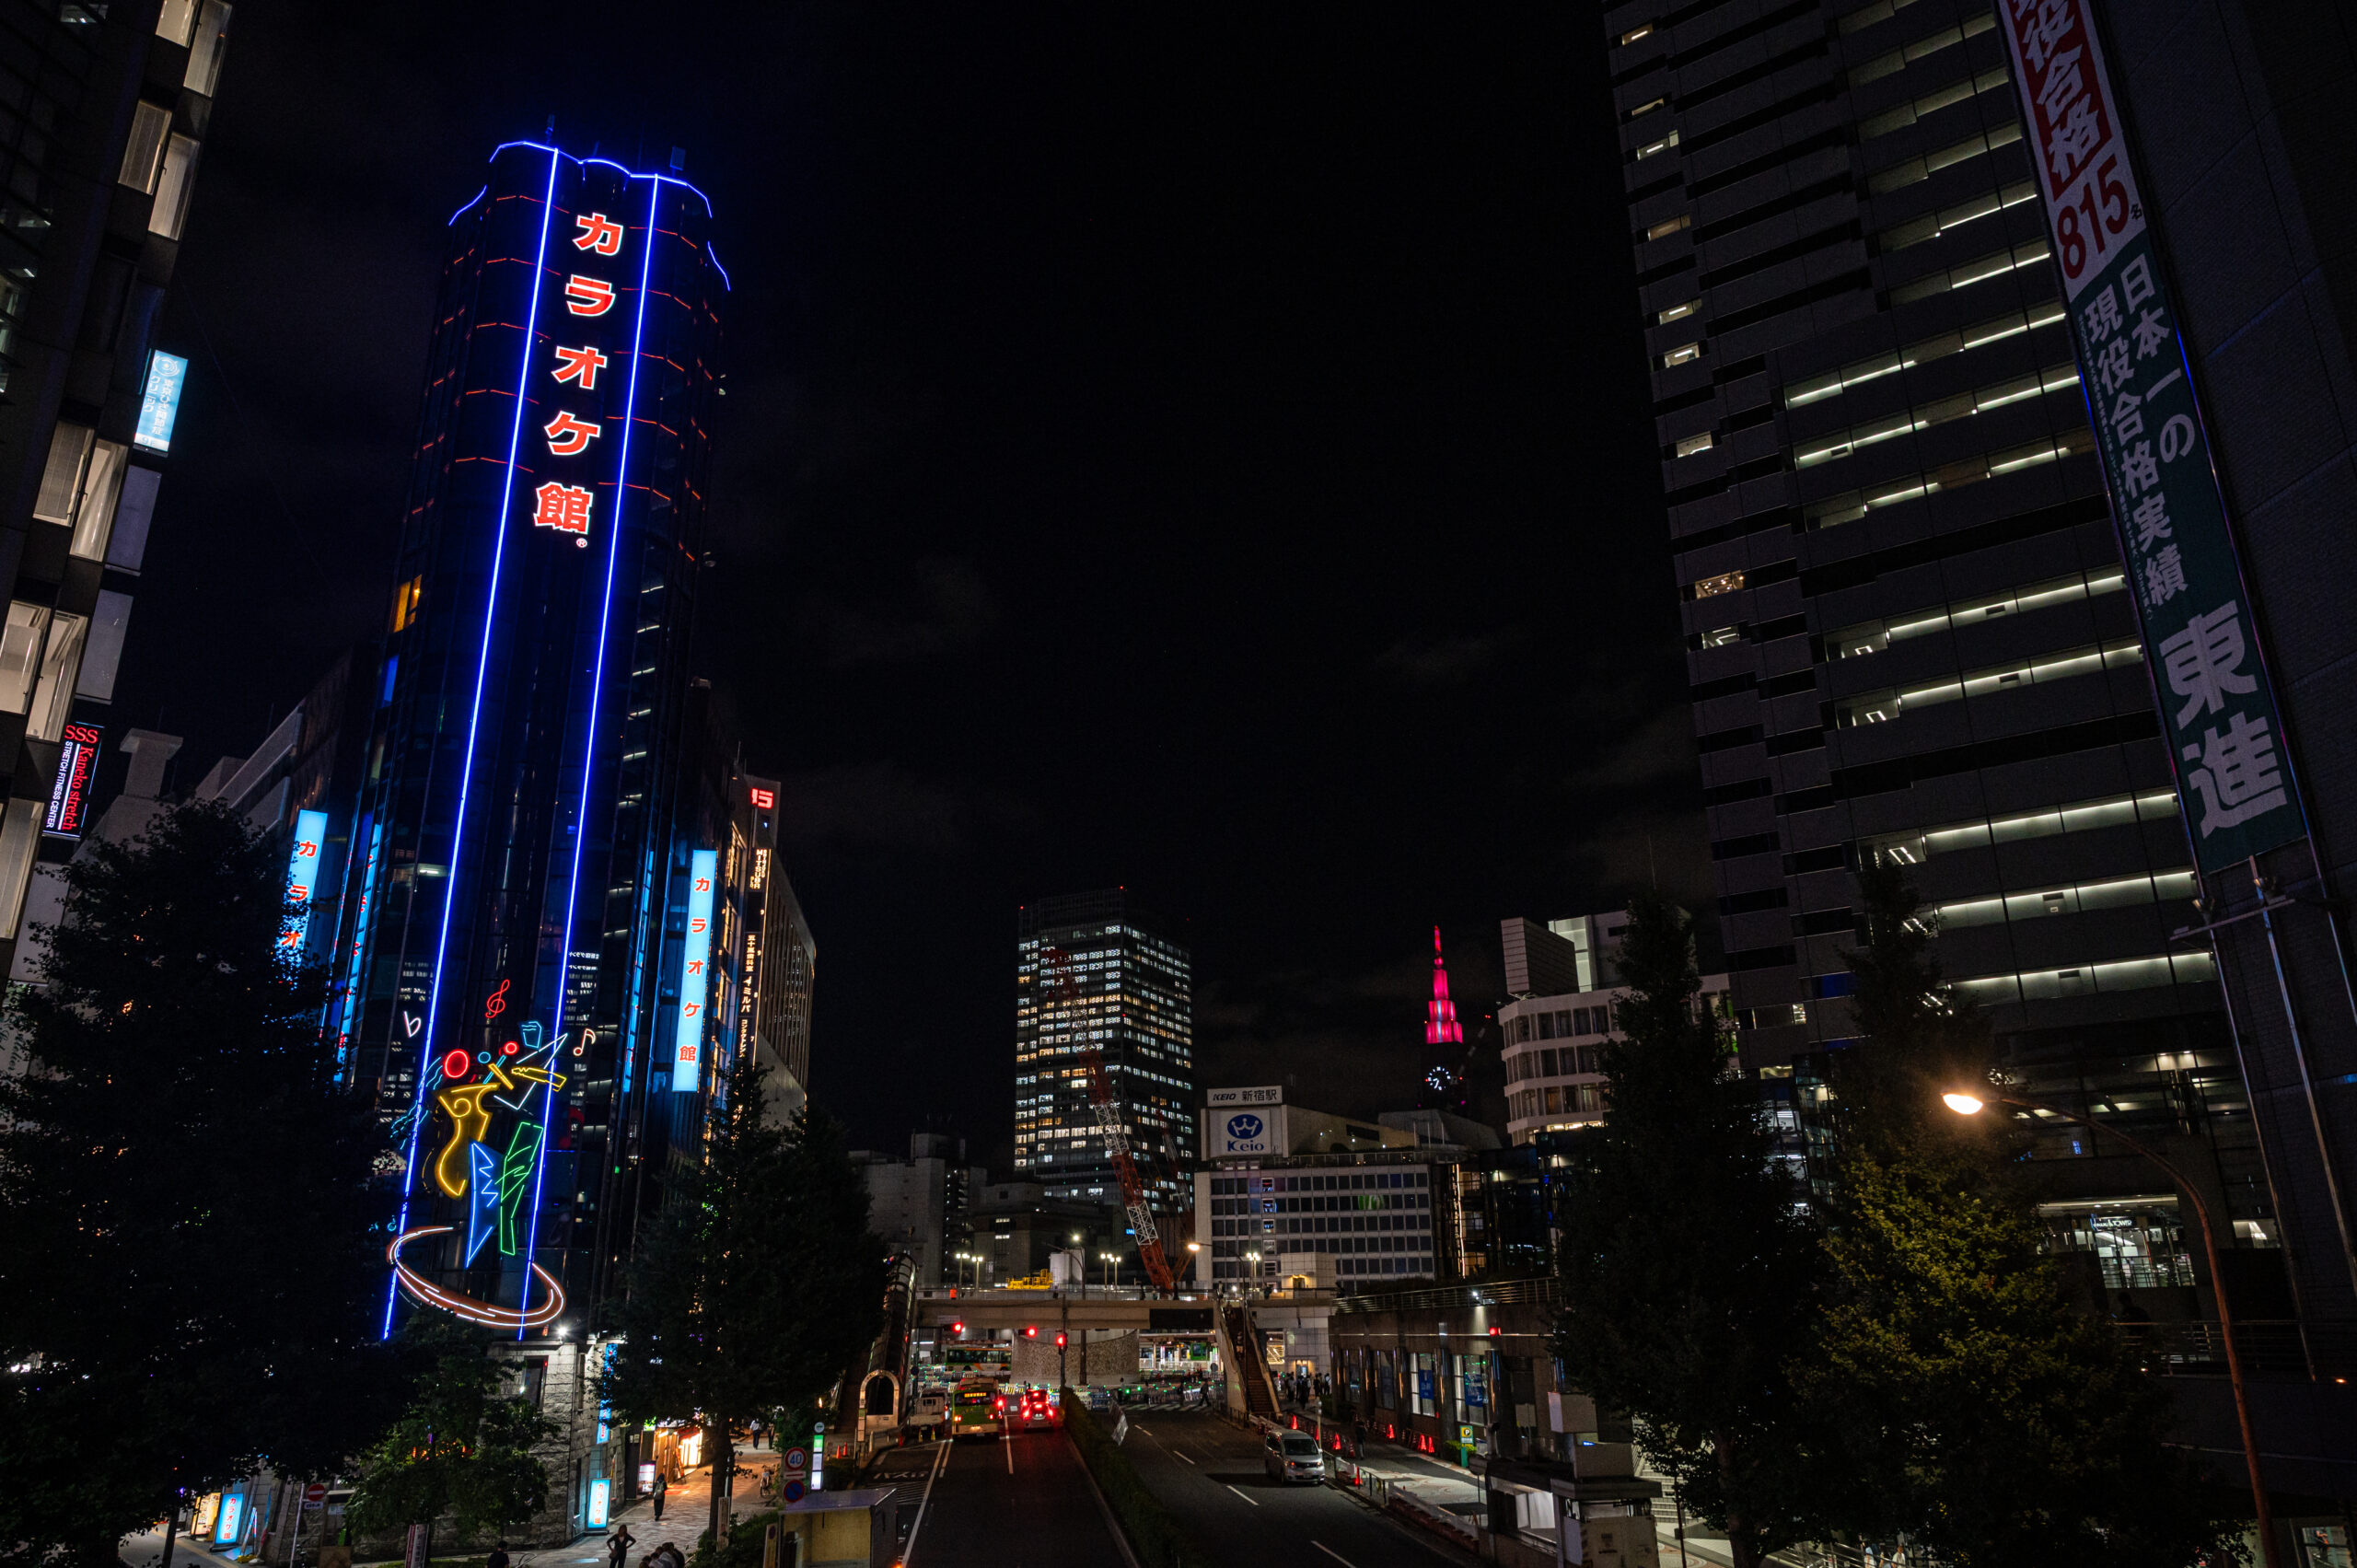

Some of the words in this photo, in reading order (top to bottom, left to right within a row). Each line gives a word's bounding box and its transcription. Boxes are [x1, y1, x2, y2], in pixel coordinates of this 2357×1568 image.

[2014, 0, 2100, 182] 役合格
[533, 212, 624, 534] カラオケ館
[2120, 252, 2196, 463] 日本一の
[2083, 283, 2189, 608] 現役合格実績
[64, 724, 99, 744] SSS
[2158, 598, 2288, 840] 東進
[59, 740, 74, 772] STRETCH
[72, 745, 94, 789] Kaneko
[52, 772, 66, 800] FITNESS
[46, 800, 60, 829] CENTER
[62, 790, 81, 830] stretch
[679, 877, 711, 1062] カラオケ館
[1213, 1093, 1237, 1101] KEIO
[1241, 1089, 1277, 1102] 新宿駅
[1227, 1140, 1265, 1152] Keio
[790, 1454, 802, 1464] 40
